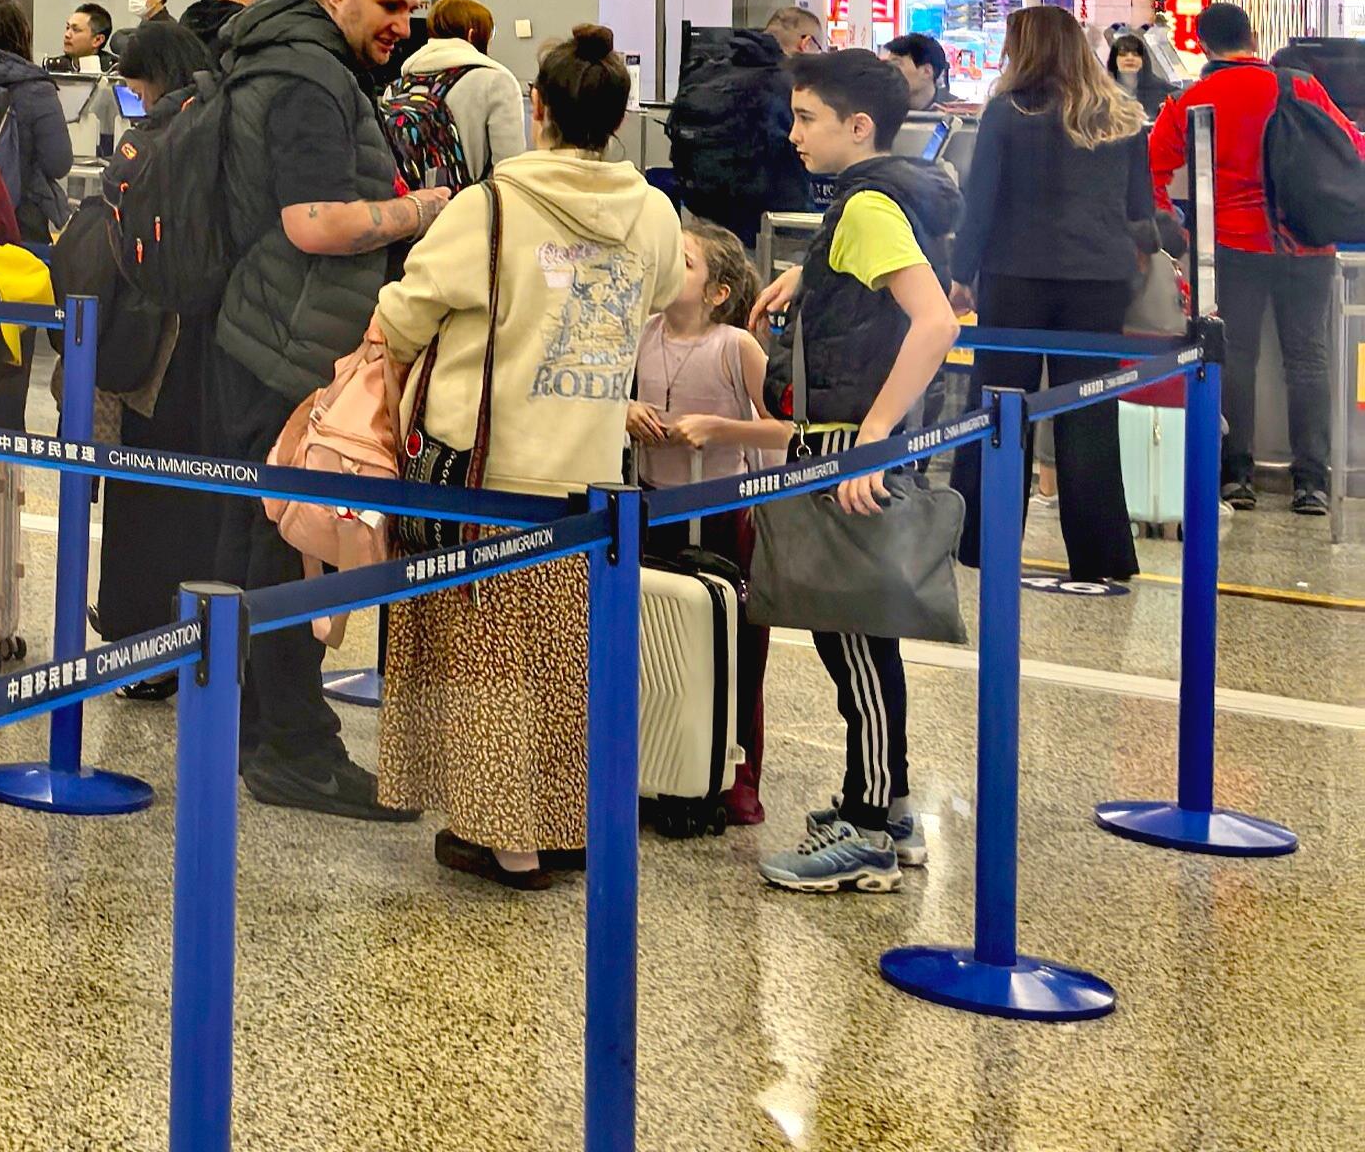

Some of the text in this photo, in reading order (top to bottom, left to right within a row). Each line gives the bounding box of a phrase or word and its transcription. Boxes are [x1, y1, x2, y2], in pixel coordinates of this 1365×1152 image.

[108, 451, 155, 470] CHINA
[157, 457, 258, 483] IMMIGRATION
[406, 527, 554, 583] 中国移民管理 CHINA IMMIGRATION
[7, 622, 201, 702] 中国移民管理 CHINA IMMIGRATION
